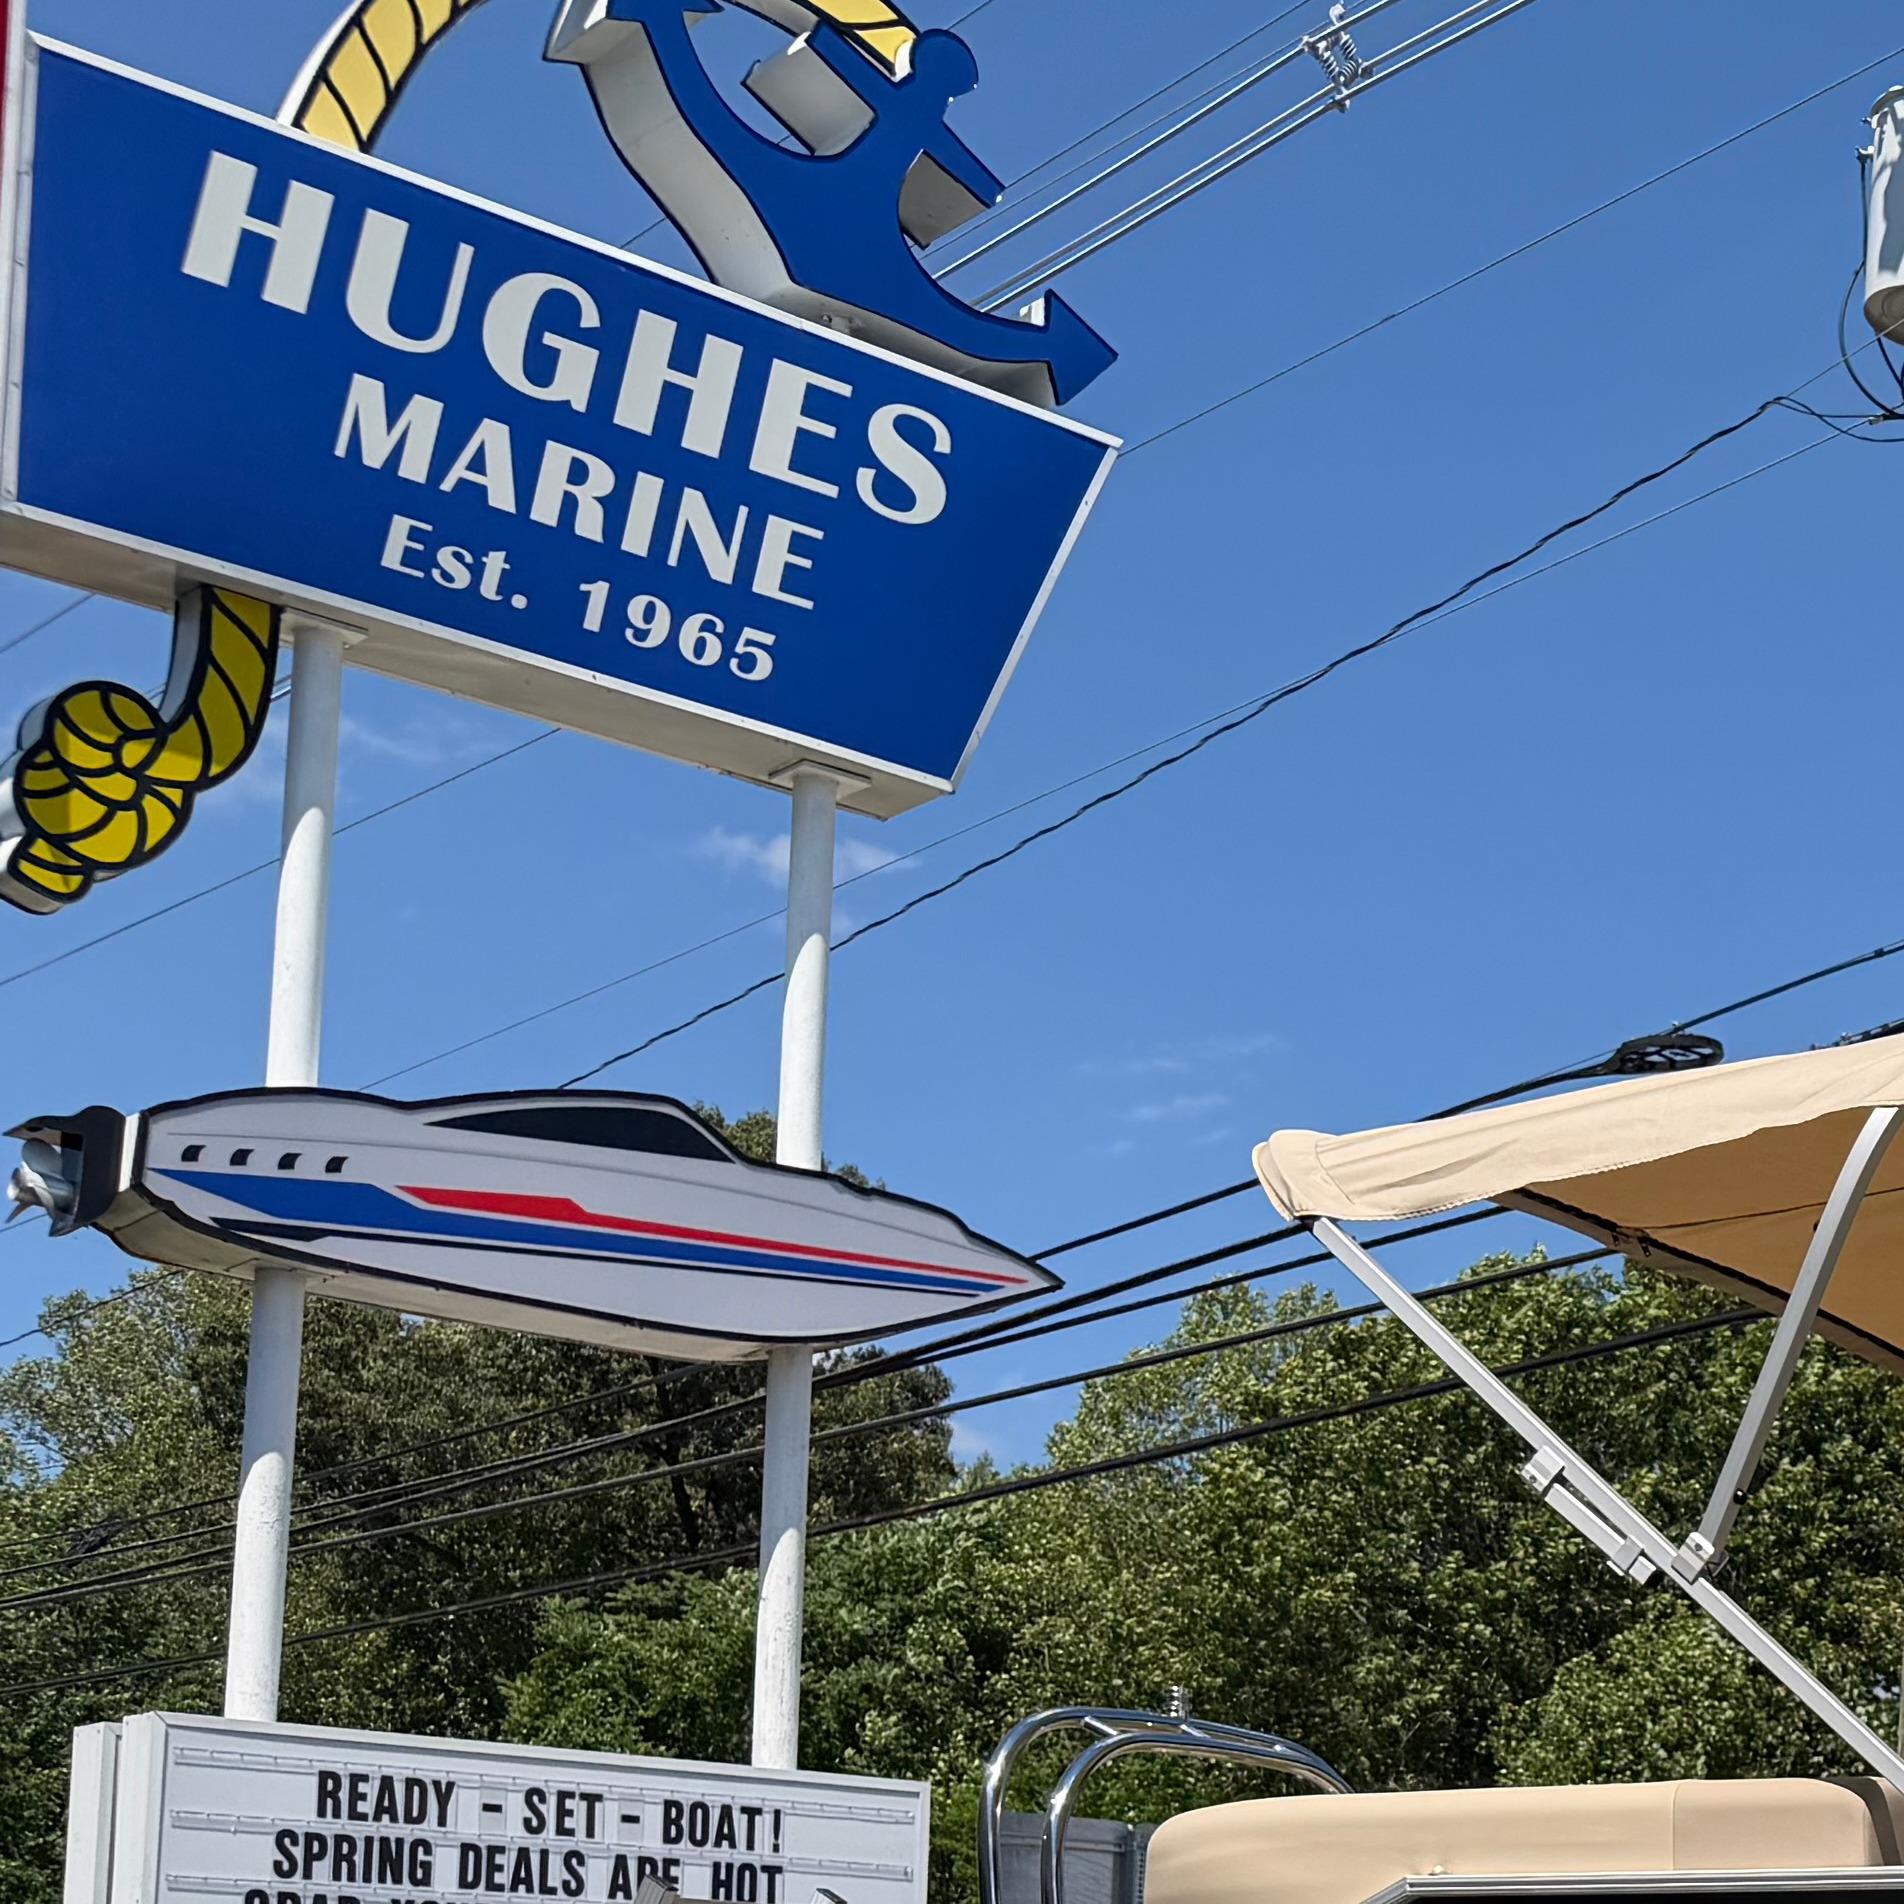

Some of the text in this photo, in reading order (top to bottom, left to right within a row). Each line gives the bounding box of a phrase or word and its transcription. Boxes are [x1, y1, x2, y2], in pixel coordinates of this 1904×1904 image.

[181, 149, 952, 526] HUGHES
[334, 372, 825, 611] MARINE
[381, 513, 777, 683] Est. 1965
[273, 1828, 433, 1888] SPRING
[458, 1842, 586, 1898] DEALS
[711, 1861, 783, 1904] HOT
[317, 1770, 456, 1828] READY
[523, 1787, 604, 1839] SET
[662, 1799, 783, 1853] BOAT!
